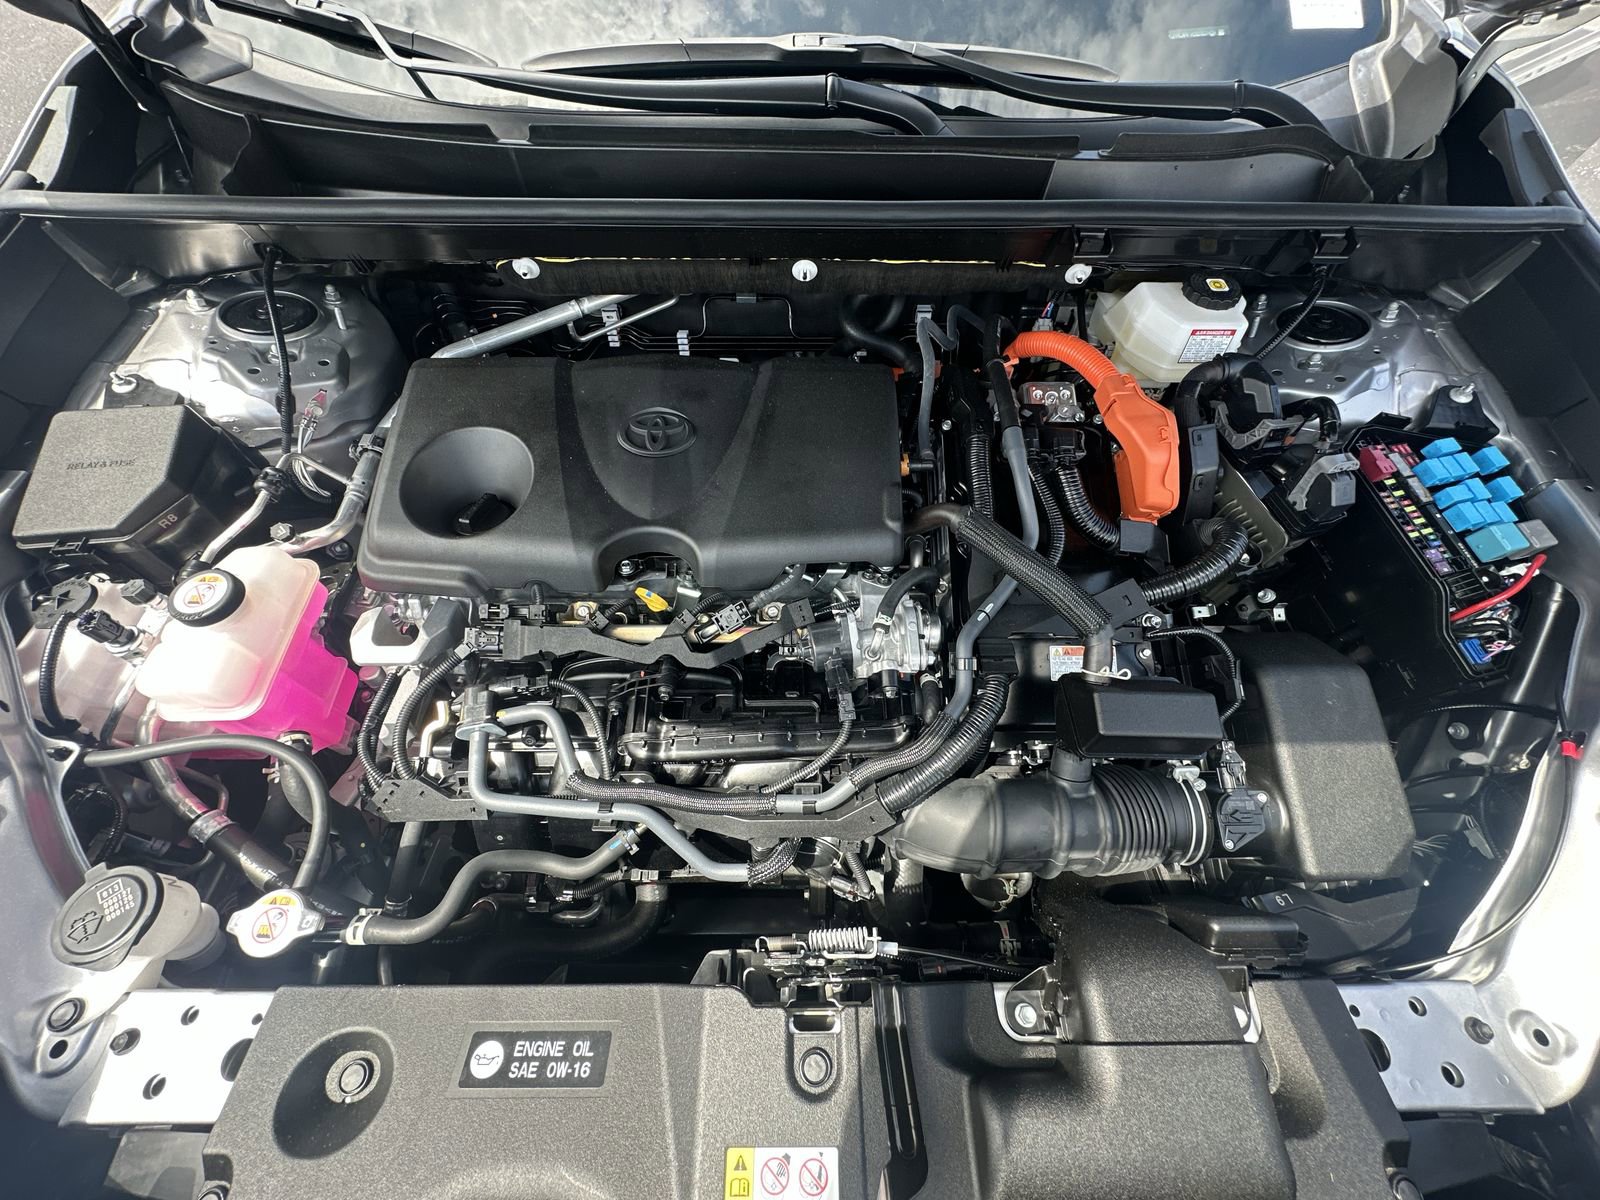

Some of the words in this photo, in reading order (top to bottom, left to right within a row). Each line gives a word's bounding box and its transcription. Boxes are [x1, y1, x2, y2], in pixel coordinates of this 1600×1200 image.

[66, 460, 100, 470] RELAY
[158, 513, 178, 529] R8
[103, 887, 131, 909] 000127
[106, 900, 135, 922] 000145
[513, 1040, 566, 1057] ENGINE
[572, 1040, 594, 1057] OIL
[508, 1061, 540, 1079] SAE
[546, 1061, 592, 1079] 0W-16
